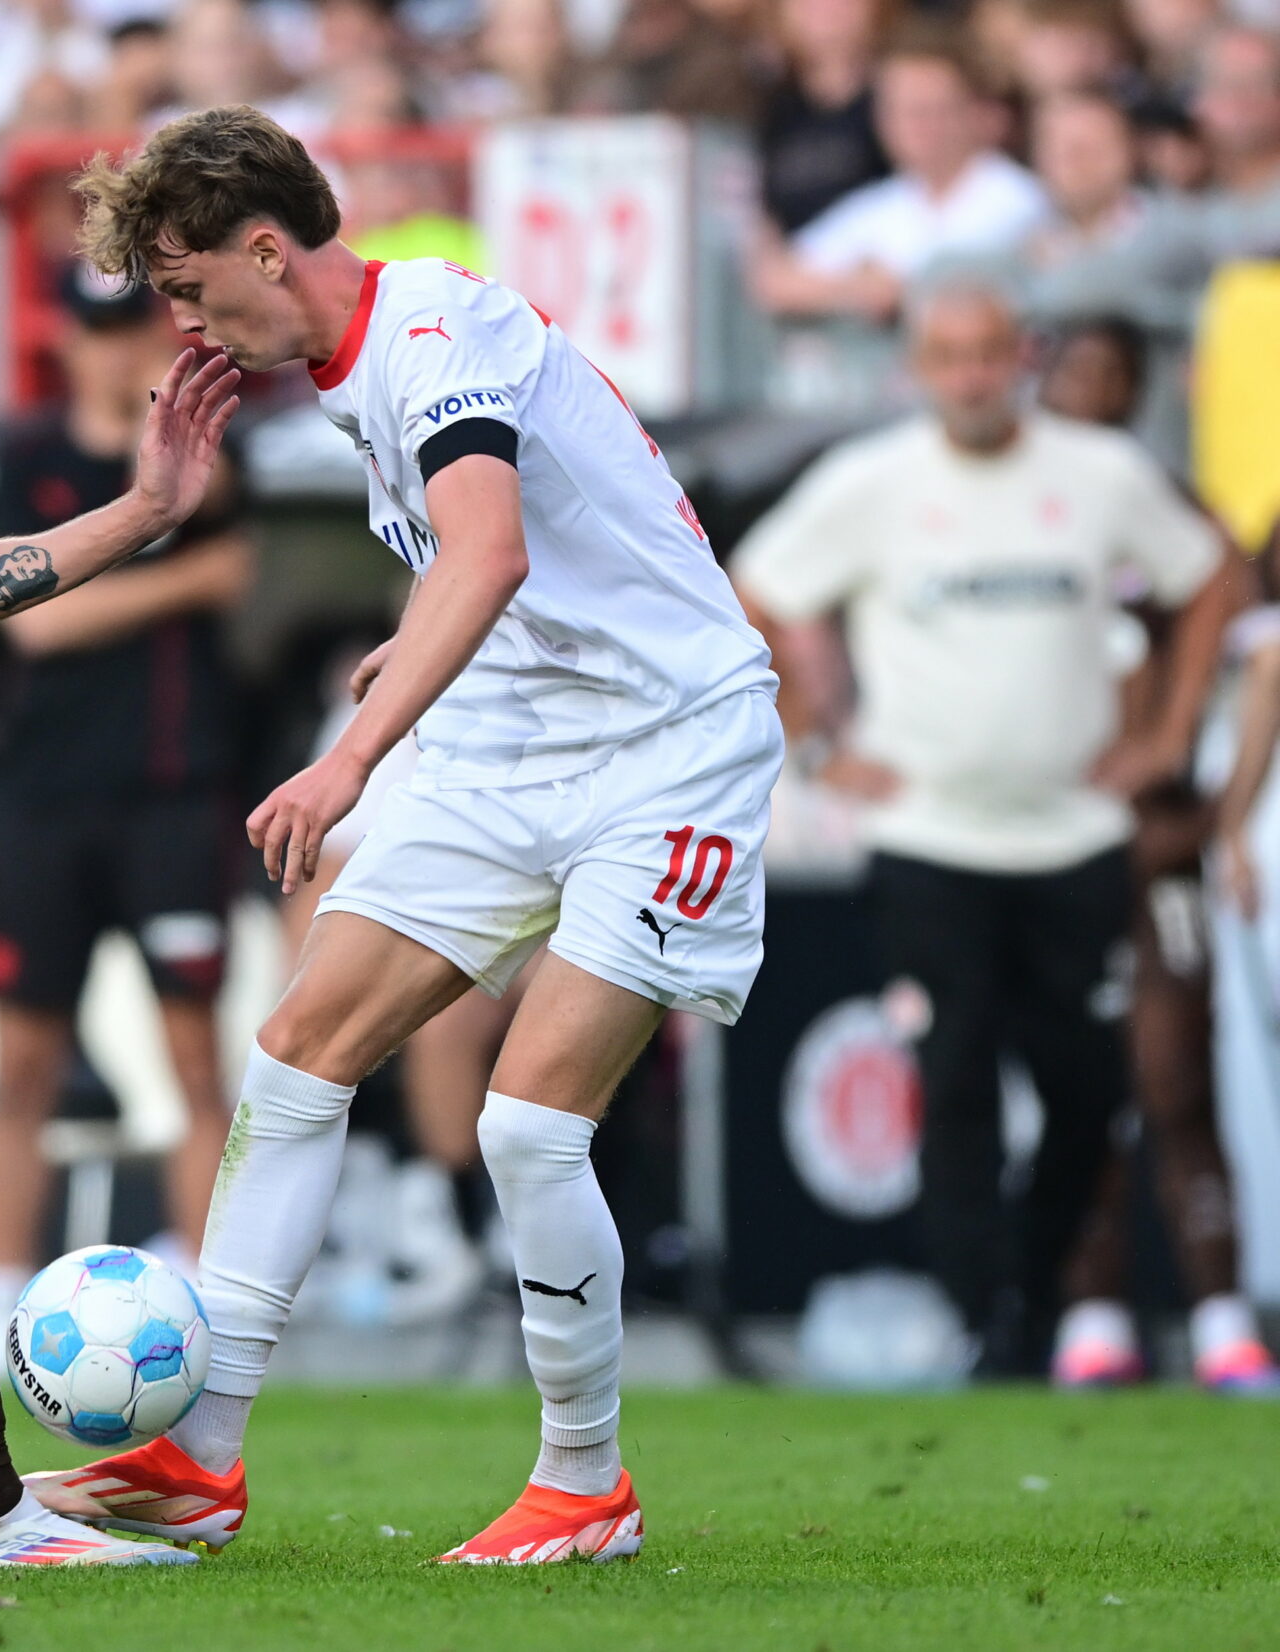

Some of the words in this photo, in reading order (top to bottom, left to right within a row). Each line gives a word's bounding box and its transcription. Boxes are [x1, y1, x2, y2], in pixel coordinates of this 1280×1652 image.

[425, 392, 505, 424] VOITH
[651, 825, 733, 920] 10
[9, 1318, 62, 1416] DERBYSTAR
